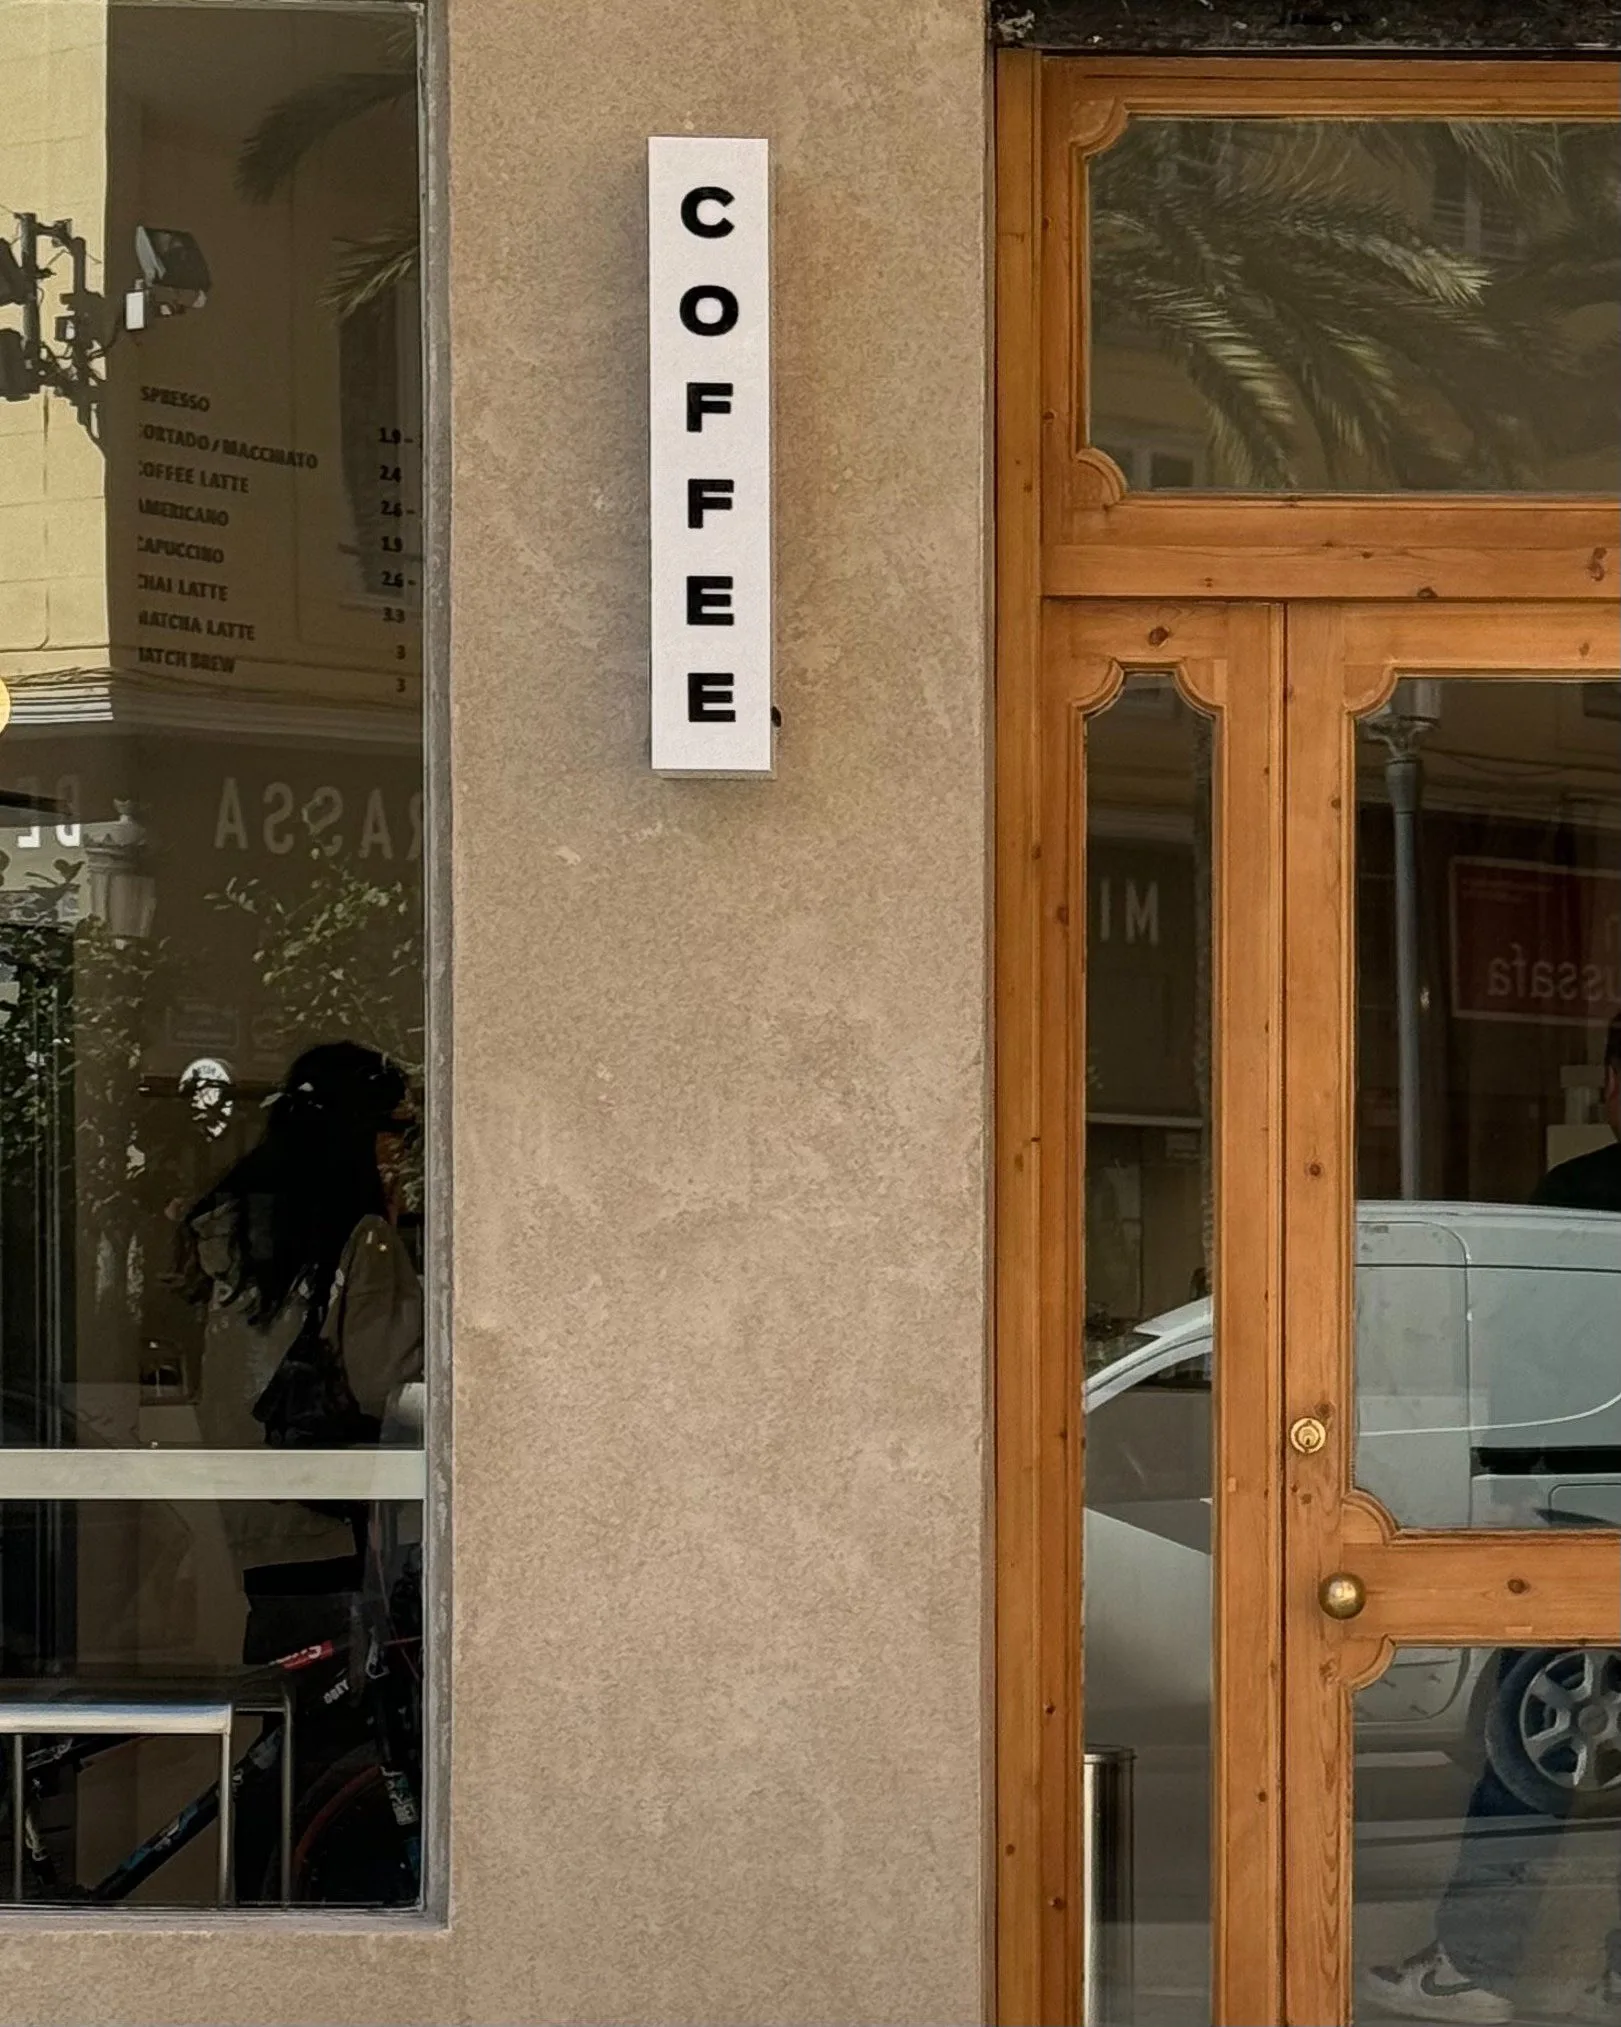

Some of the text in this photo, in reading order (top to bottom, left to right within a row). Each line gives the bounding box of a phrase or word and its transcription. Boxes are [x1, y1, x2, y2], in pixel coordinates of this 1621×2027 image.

[679, 186, 739, 722] COFFEE
[200, 470, 249, 493] LATTE
[178, 580, 228, 601] LATTE
[207, 620, 256, 641] LATTE
